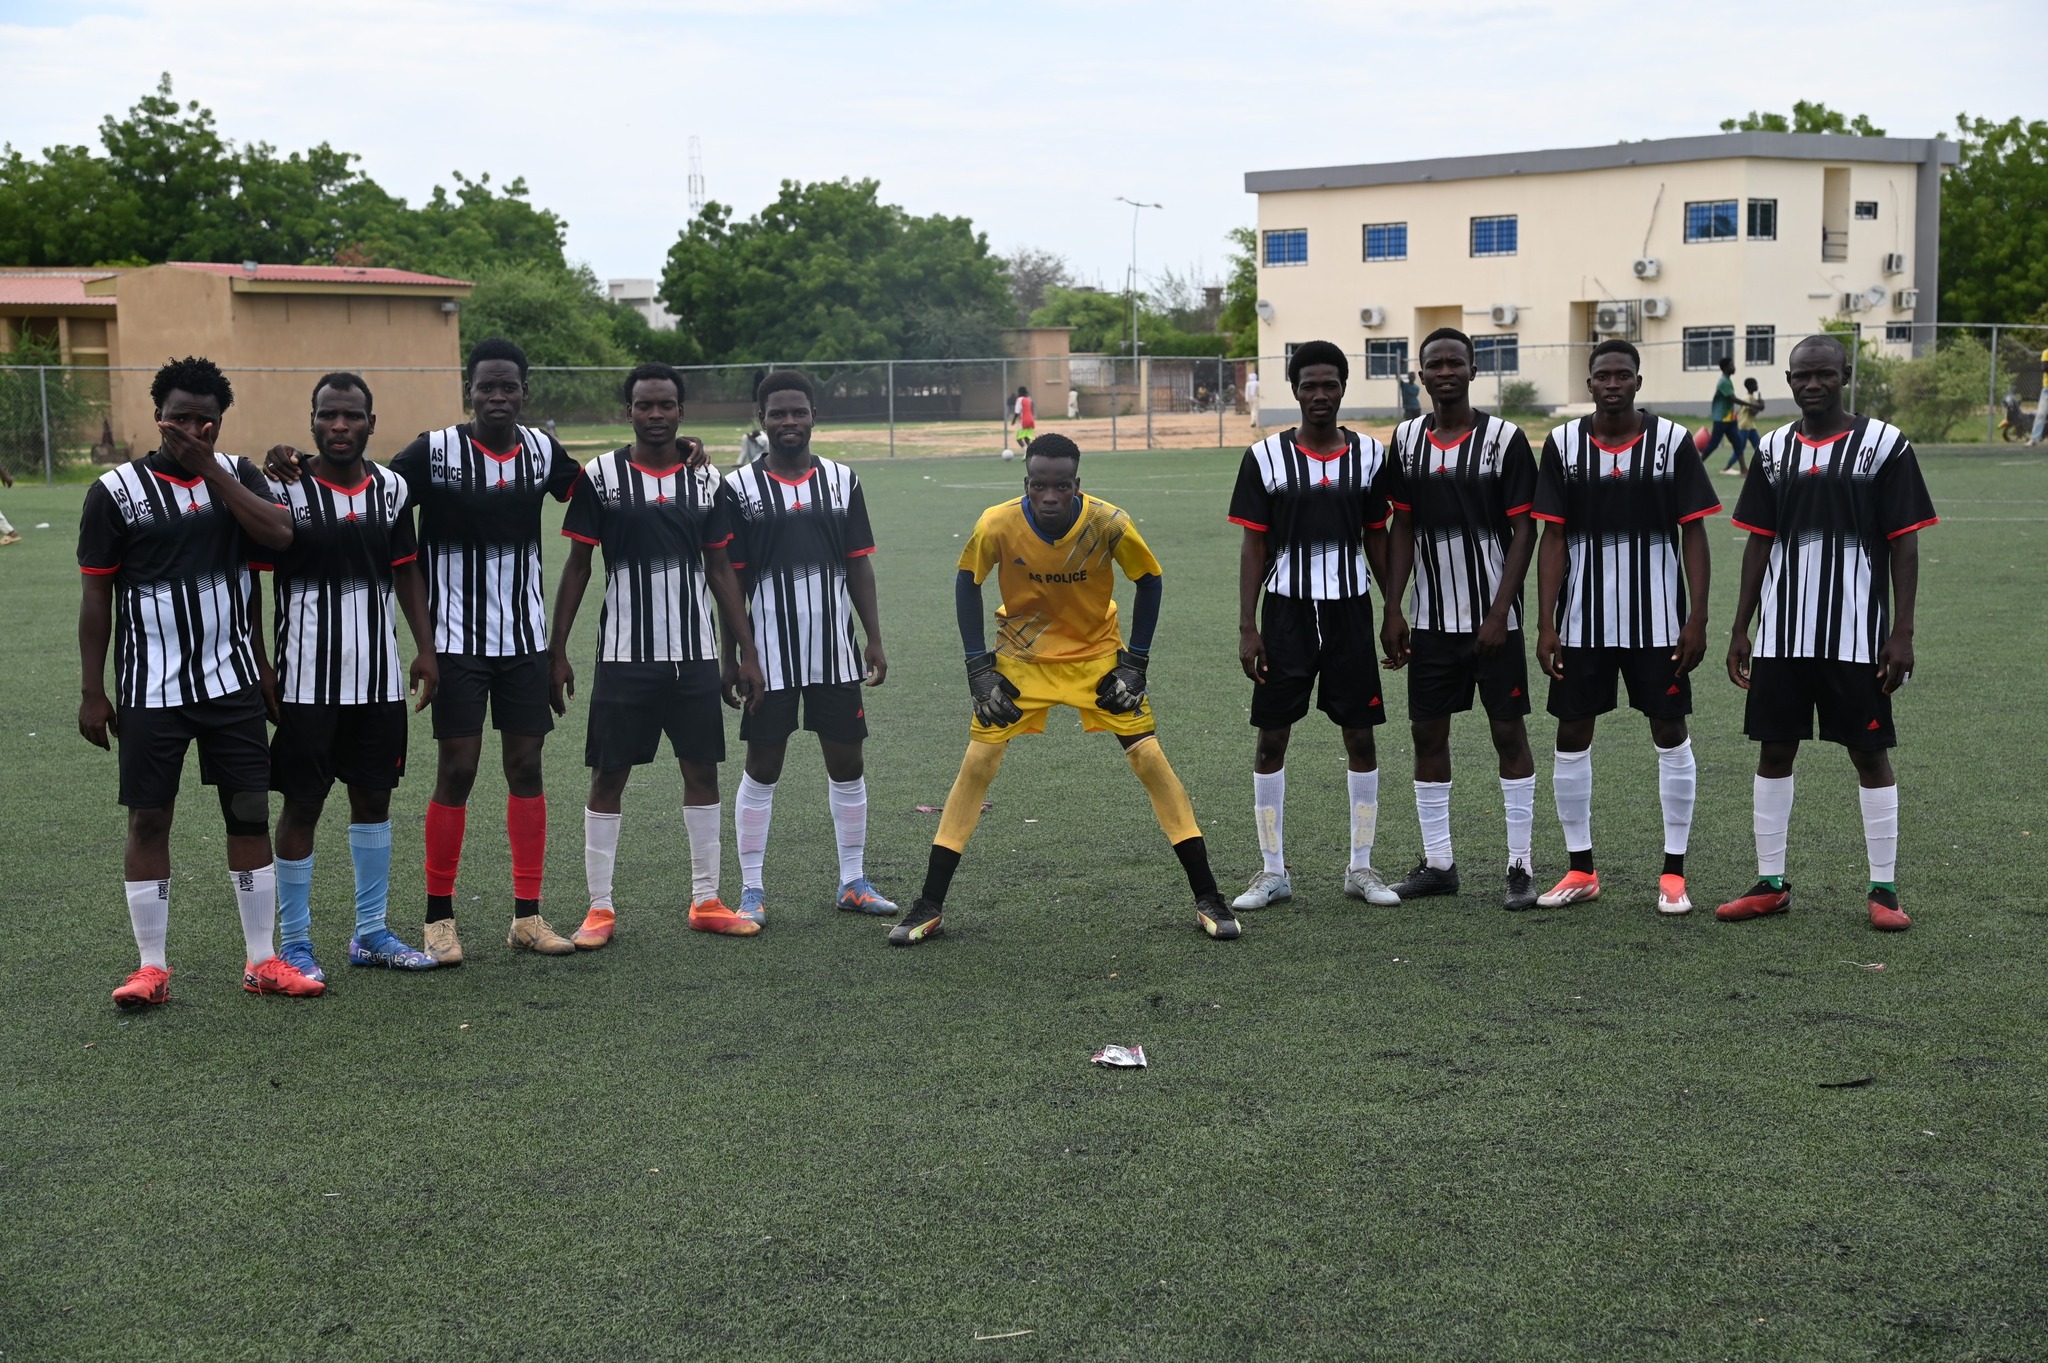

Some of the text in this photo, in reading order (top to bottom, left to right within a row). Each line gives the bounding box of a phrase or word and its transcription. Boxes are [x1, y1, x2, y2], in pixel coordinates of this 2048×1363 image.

[432, 448, 443, 462] AS
[1656, 443, 1666, 471] 3
[1859, 446, 1873, 474] 18
[113, 488, 127, 506] AS
[122, 499, 153, 520] POICE
[741, 500, 764, 519] POICE
[1029, 570, 1087, 584] AS POLICE
